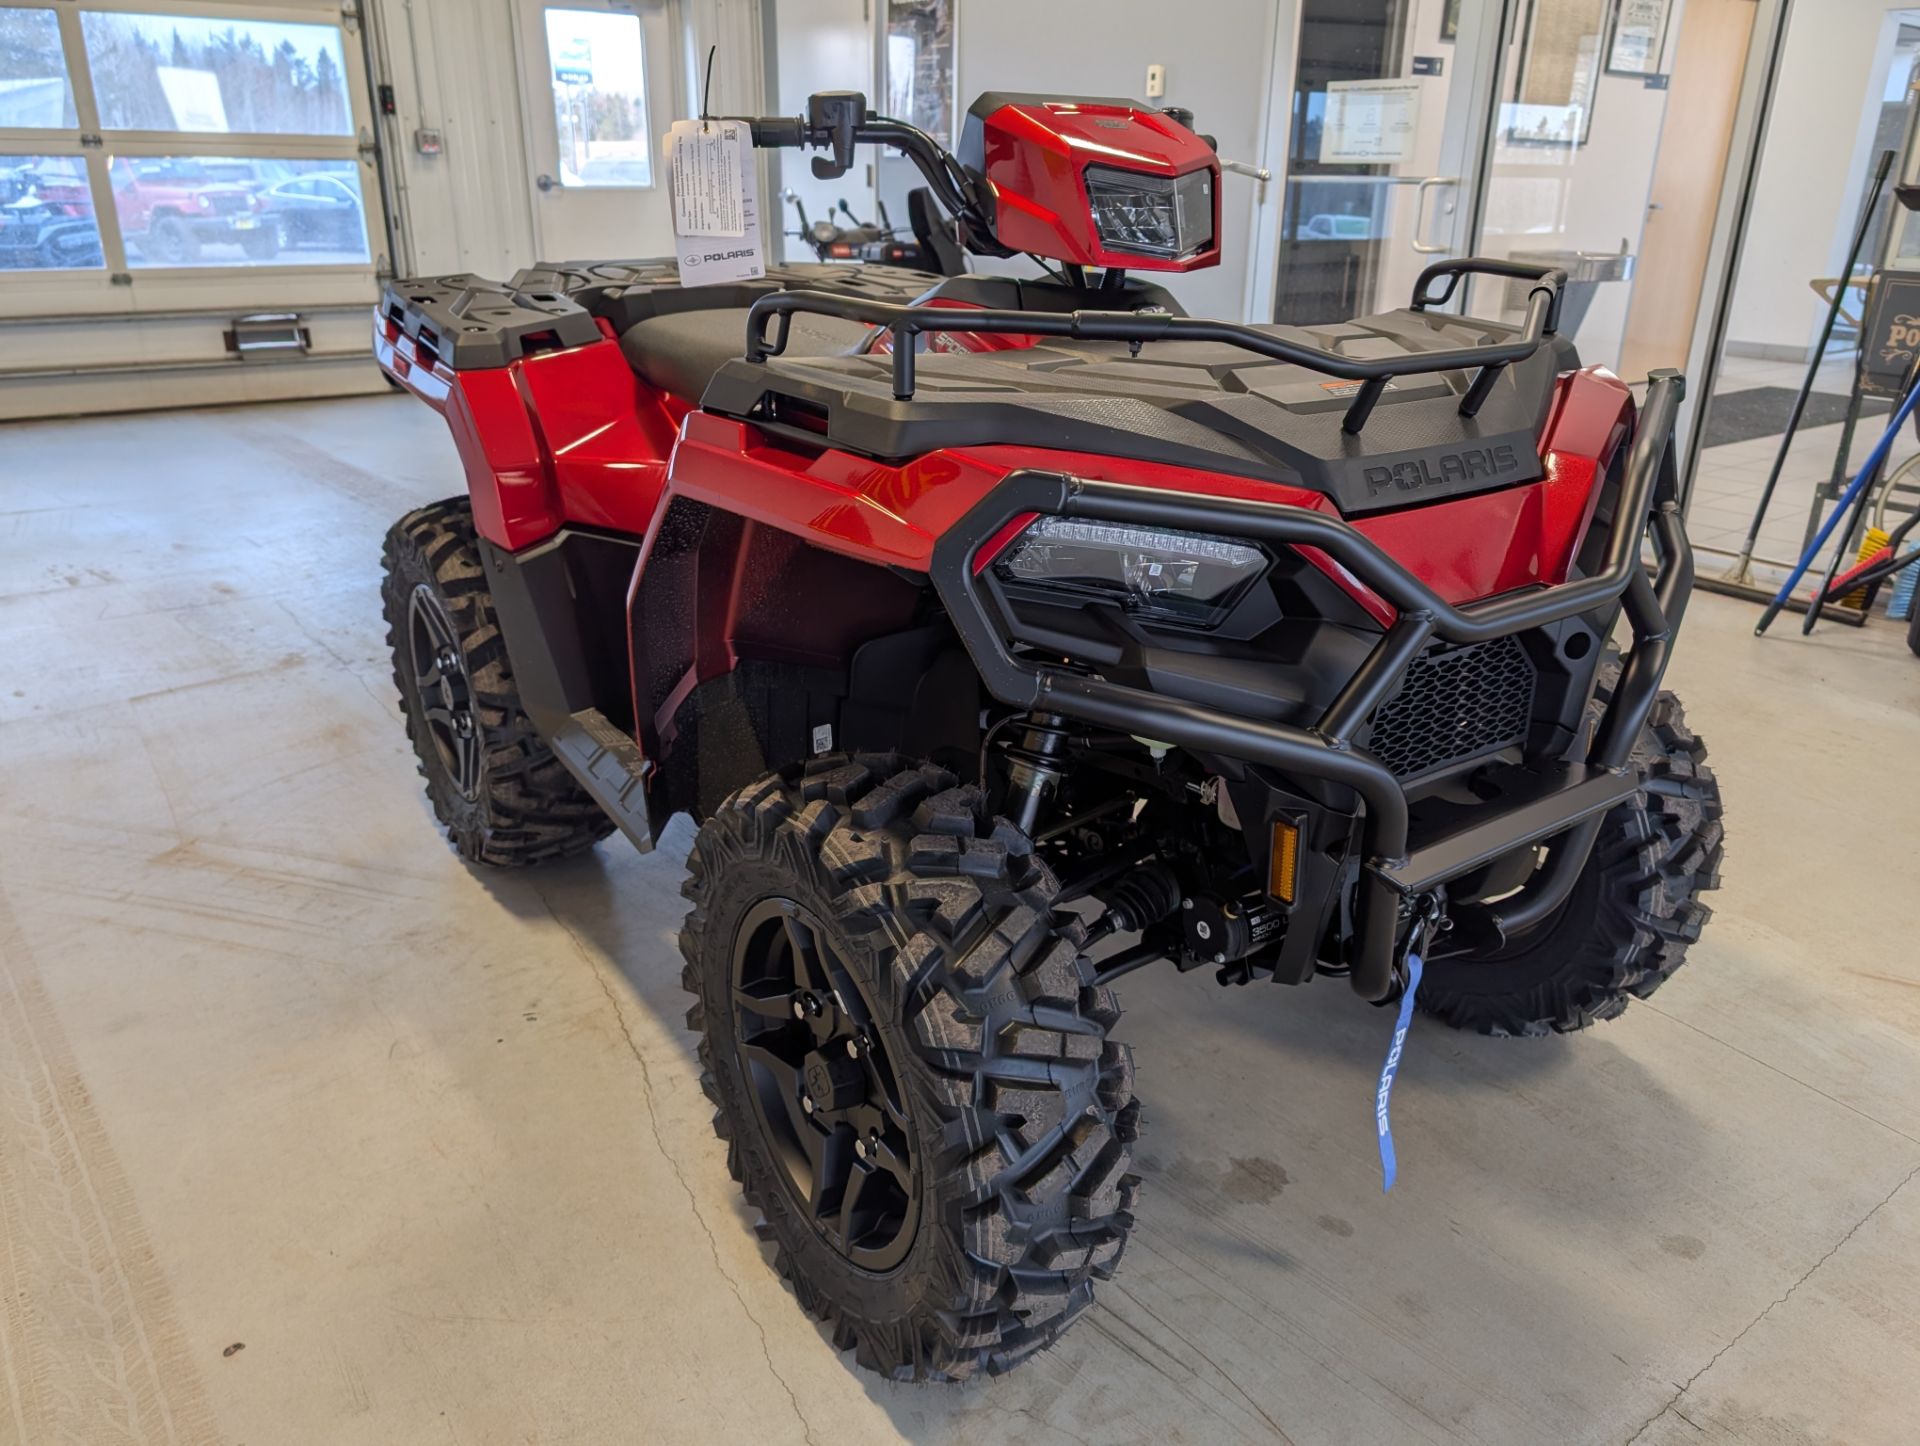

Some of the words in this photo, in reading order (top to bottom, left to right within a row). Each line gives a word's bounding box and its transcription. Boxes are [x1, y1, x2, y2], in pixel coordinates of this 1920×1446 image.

[703, 249, 755, 263] POLARIS
[1363, 445, 1518, 497] POLARIS
[1252, 920, 1280, 937] 3500
[1378, 1027, 1407, 1136] POLARIS
